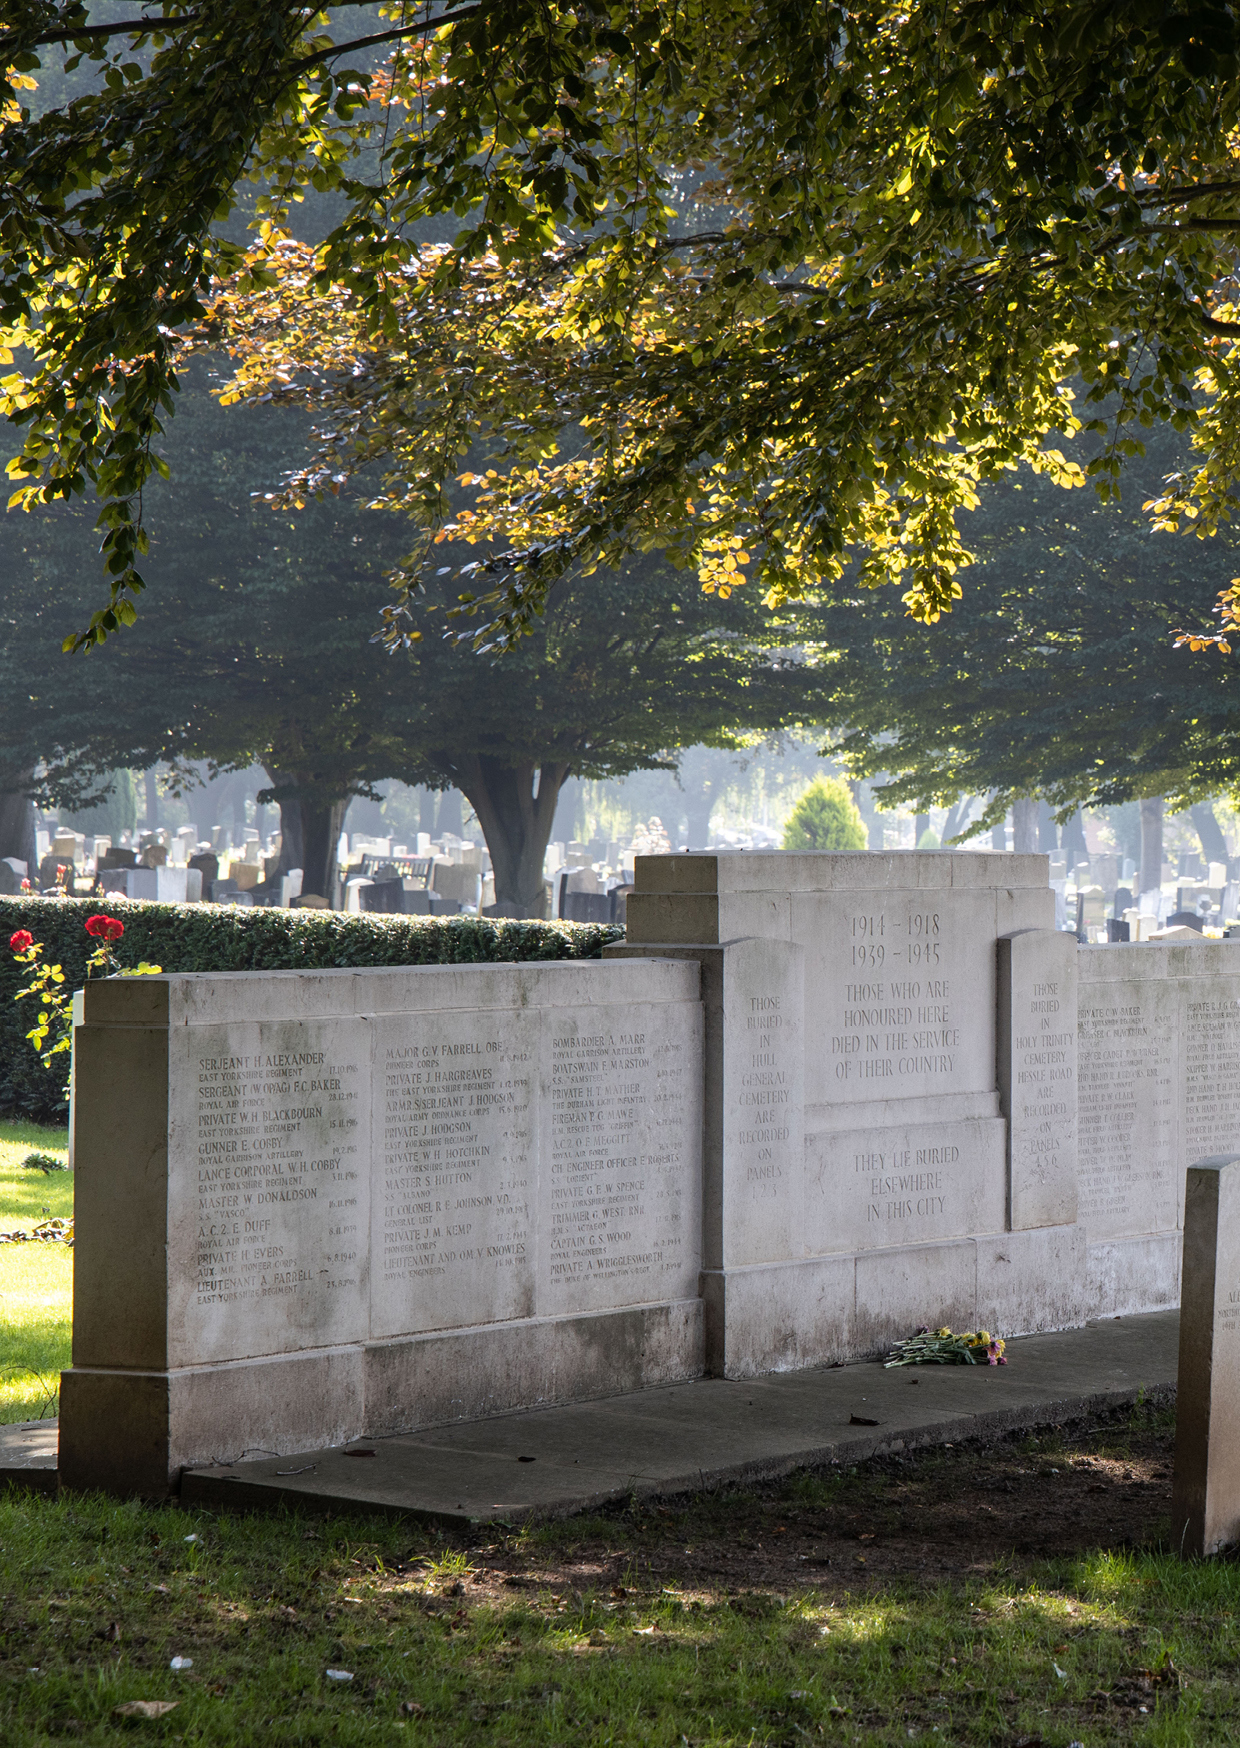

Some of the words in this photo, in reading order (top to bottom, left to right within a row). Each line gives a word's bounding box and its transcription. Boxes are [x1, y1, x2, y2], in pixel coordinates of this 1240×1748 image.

[852, 914, 885, 939] 1914
[908, 913, 940, 936] 1918
[852, 944, 885, 968] 1939
[908, 942, 940, 966] 1945
[844, 983, 884, 1002] THOSE
[890, 982, 921, 1000] WHO
[925, 980, 949, 999] ARE
[1033, 982, 1058, 996] THOSE
[750, 996, 780, 1012] THOSE
[1030, 999, 1060, 1014] BURIED
[747, 1014, 783, 1030] BURIED
[844, 1007, 912, 1029] HONOURED
[918, 1005, 949, 1024] HERE
[1041, 1018, 1050, 1030] IN
[553, 1035, 605, 1049] BOMBARDIER
[619, 1034, 645, 1045] MARR
[760, 1034, 771, 1048] IN
[831, 1035, 860, 1054] DIED
[866, 1034, 879, 1052] IN
[884, 1032, 908, 1051] THE
[912, 1029, 960, 1049] SERVICE
[1016, 1036, 1038, 1049] HOLY
[1041, 1033, 1074, 1048] TRINITY
[385, 1046, 419, 1059] MAJOR
[576, 1048, 609, 1058] GARRISON
[611, 1046, 645, 1056] ARTILLERY
[752, 1053, 777, 1068] HULL
[1024, 1051, 1066, 1065] CEMETERY
[199, 1056, 250, 1071] SERJEANT
[265, 1052, 325, 1067] ALEXANDER
[552, 1062, 599, 1075] BOATSWAIN
[611, 1058, 649, 1070] MARSTON
[835, 1061, 852, 1079] OF
[857, 1058, 893, 1078] THEIR
[898, 1054, 955, 1075] COUNTRY
[199, 1072, 219, 1082] EAST
[222, 1070, 263, 1081] YORKSHIRE
[266, 1068, 303, 1078] REGIMENT
[385, 1073, 422, 1086] PRIVATE
[434, 1068, 493, 1083] HARGREAVES
[741, 1070, 786, 1087] GENERAL
[1017, 1069, 1046, 1084] HESSLE
[1049, 1067, 1072, 1081] ROAD
[198, 1084, 247, 1099] SERGEANT
[311, 1079, 341, 1091] BAKER
[552, 1087, 583, 1100] PRIVATE
[604, 1083, 640, 1096] MATHER
[738, 1089, 790, 1106] CEMETERY
[1036, 1085, 1054, 1099] ARE
[198, 1100, 223, 1111] ROYAL
[226, 1100, 239, 1108] AIR
[242, 1098, 265, 1107] FORCE
[476, 1091, 515, 1106] HODGSON
[198, 1112, 236, 1126] PRIVATE
[262, 1107, 323, 1121] BLACKBOURN
[385, 1114, 406, 1124] ROYAL
[408, 1113, 428, 1122] ARMY
[431, 1109, 467, 1120] ORDNANCE
[469, 1107, 490, 1116] CORPS
[552, 1111, 587, 1125] FIREMAN
[607, 1108, 633, 1120] MAWE
[754, 1109, 775, 1124] ARE
[1024, 1102, 1066, 1118] RECORDED
[198, 1129, 216, 1138] EAST
[218, 1126, 260, 1137] YORKSHIRE
[264, 1122, 301, 1133] REGIMENT
[384, 1126, 419, 1139] PRIVATE
[431, 1121, 472, 1135] HODGSON
[738, 1126, 790, 1145] RECORDED
[1039, 1121, 1052, 1133] ON
[198, 1140, 237, 1155] GUNNER
[253, 1137, 283, 1150] COBBY
[758, 1147, 772, 1160] ON
[1030, 1138, 1060, 1152] PANELS
[198, 1156, 223, 1165] ROYAL
[225, 1153, 262, 1163] GARRISON
[267, 1150, 304, 1160] ARTILLERY
[385, 1152, 419, 1164] PRIVATE
[446, 1146, 490, 1159] HOTCHKIN
[853, 1152, 887, 1172] THEY
[893, 1150, 911, 1168] LIE
[916, 1146, 959, 1165] BURIED
[198, 1167, 235, 1182] LANCE
[234, 1163, 284, 1178] CORPORAL
[311, 1158, 341, 1172] COBBY
[567, 1160, 605, 1173] ENGINEER
[606, 1156, 638, 1169] OFFICER
[747, 1165, 782, 1181] PANELS
[385, 1177, 421, 1190] MASTER
[435, 1172, 472, 1185] HUTTON
[871, 1171, 942, 1195] ELSEWHERE
[551, 1186, 584, 1200] PRIVATE
[616, 1180, 645, 1192] SPENCE
[198, 1195, 239, 1210] MASTER
[257, 1188, 317, 1204] DONALDSON
[397, 1202, 433, 1215] COLONEL
[552, 1210, 590, 1224] TRIMMER
[867, 1203, 880, 1222] IN
[885, 1199, 912, 1219] THIS
[917, 1196, 946, 1216] CITY
[244, 1219, 271, 1233] DUFF
[384, 1229, 420, 1243] PRIVATE
[446, 1224, 472, 1236] KEMP
[197, 1240, 223, 1250] ROYAL
[226, 1237, 240, 1246] AIR
[243, 1234, 266, 1244] FORCE
[550, 1236, 586, 1250] CAPTAIN
[606, 1231, 631, 1242] WOOD
[197, 1251, 237, 1266] PRIVATE
[254, 1246, 284, 1259] EVERS
[384, 1253, 435, 1270] LIEUTENANT
[438, 1251, 456, 1263] AND
[486, 1242, 526, 1257] KNOWLES
[550, 1261, 583, 1276] PRIVATE
[597, 1251, 663, 1269] WRIGGLESWORTH
[241, 1260, 272, 1273] PIONEER
[274, 1258, 298, 1268] CORPS
[409, 1267, 446, 1278] ENGINEERS
[197, 1277, 256, 1293] LIEUTENANT
[274, 1269, 313, 1284] FARRELL
